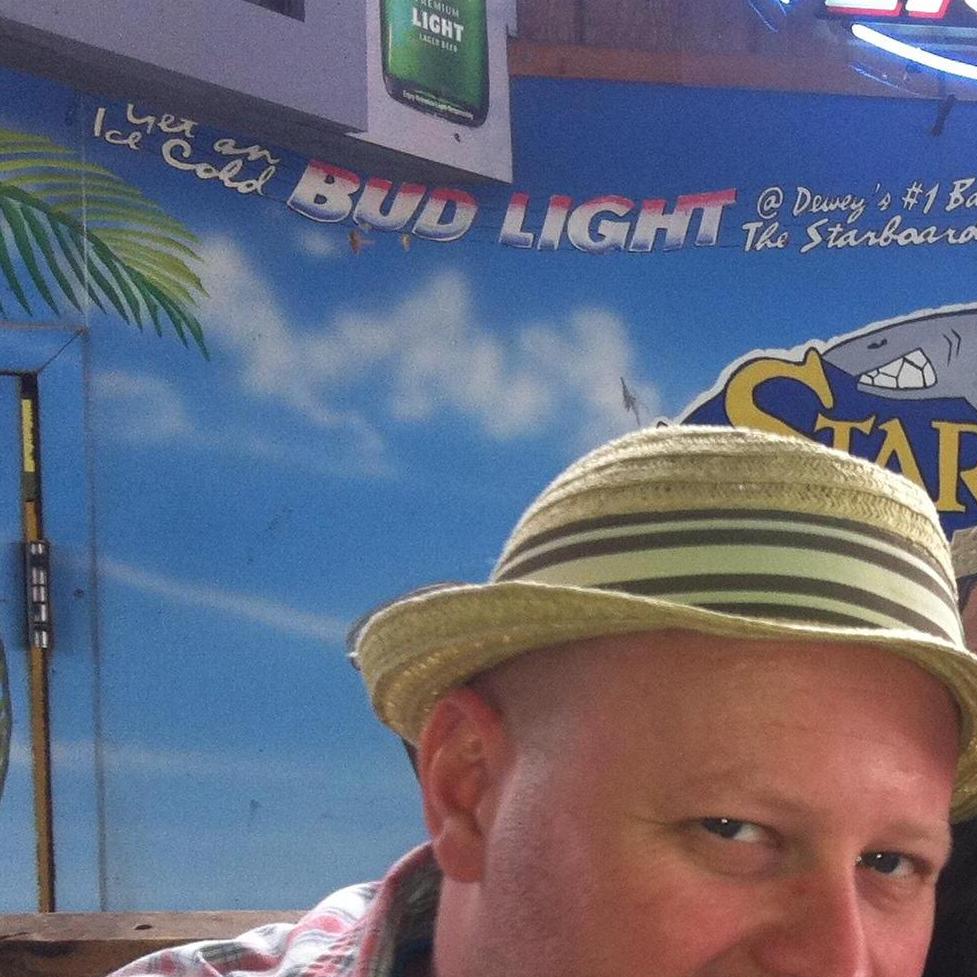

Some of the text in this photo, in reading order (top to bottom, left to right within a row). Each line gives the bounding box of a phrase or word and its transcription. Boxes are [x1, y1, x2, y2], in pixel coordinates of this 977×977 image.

[411, 7, 464, 42] LIGHT
[94, 107, 276, 195] Ice Cold
[213, 138, 280, 165] an
[288, 159, 737, 253] BUD LIGHT
[757, 187, 784, 219] @
[792, 183, 891, 224] Dewey's
[901, 181, 939, 214] #1
[741, 221, 789, 252] The
